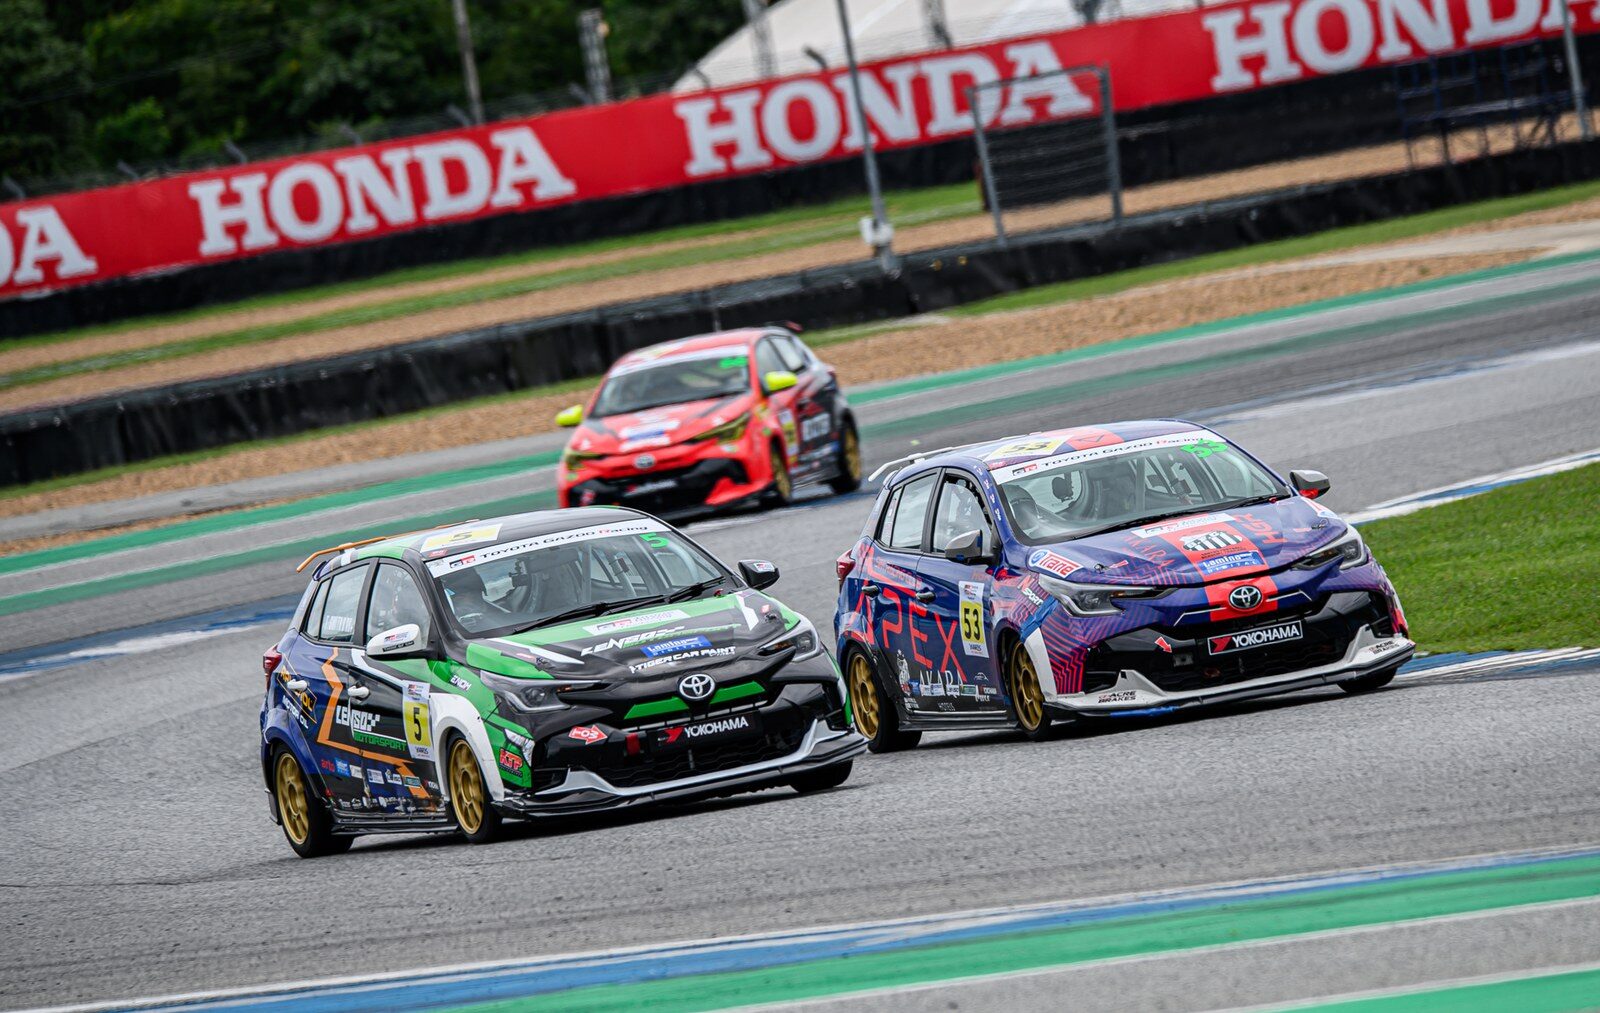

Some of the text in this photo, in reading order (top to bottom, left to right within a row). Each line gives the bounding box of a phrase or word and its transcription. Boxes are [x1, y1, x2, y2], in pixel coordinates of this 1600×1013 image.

[674, 39, 1093, 177] HONDA
[188, 126, 577, 257] HONDA
[1043, 451, 1099, 467] TOYOTA
[1102, 442, 1153, 455] GAZOO
[481, 541, 539, 559] TOYOTA
[543, 531, 595, 544] GAZOO
[599, 525, 649, 536] Racing
[639, 532, 669, 548] 5
[1039, 553, 1081, 577] Trane
[1021, 583, 1044, 606] SPORT
[963, 606, 981, 641] 53
[1231, 624, 1300, 648] YOKOHAMA
[673, 649, 700, 661] CAR
[700, 646, 737, 656] PAINT
[1098, 695, 1136, 704] BRAKES
[1109, 690, 1137, 698] ACRE
[282, 695, 300, 720] MOTOR
[299, 716, 309, 730] OIL
[413, 706, 422, 742] 5
[684, 715, 749, 738] YOKOHAMA
